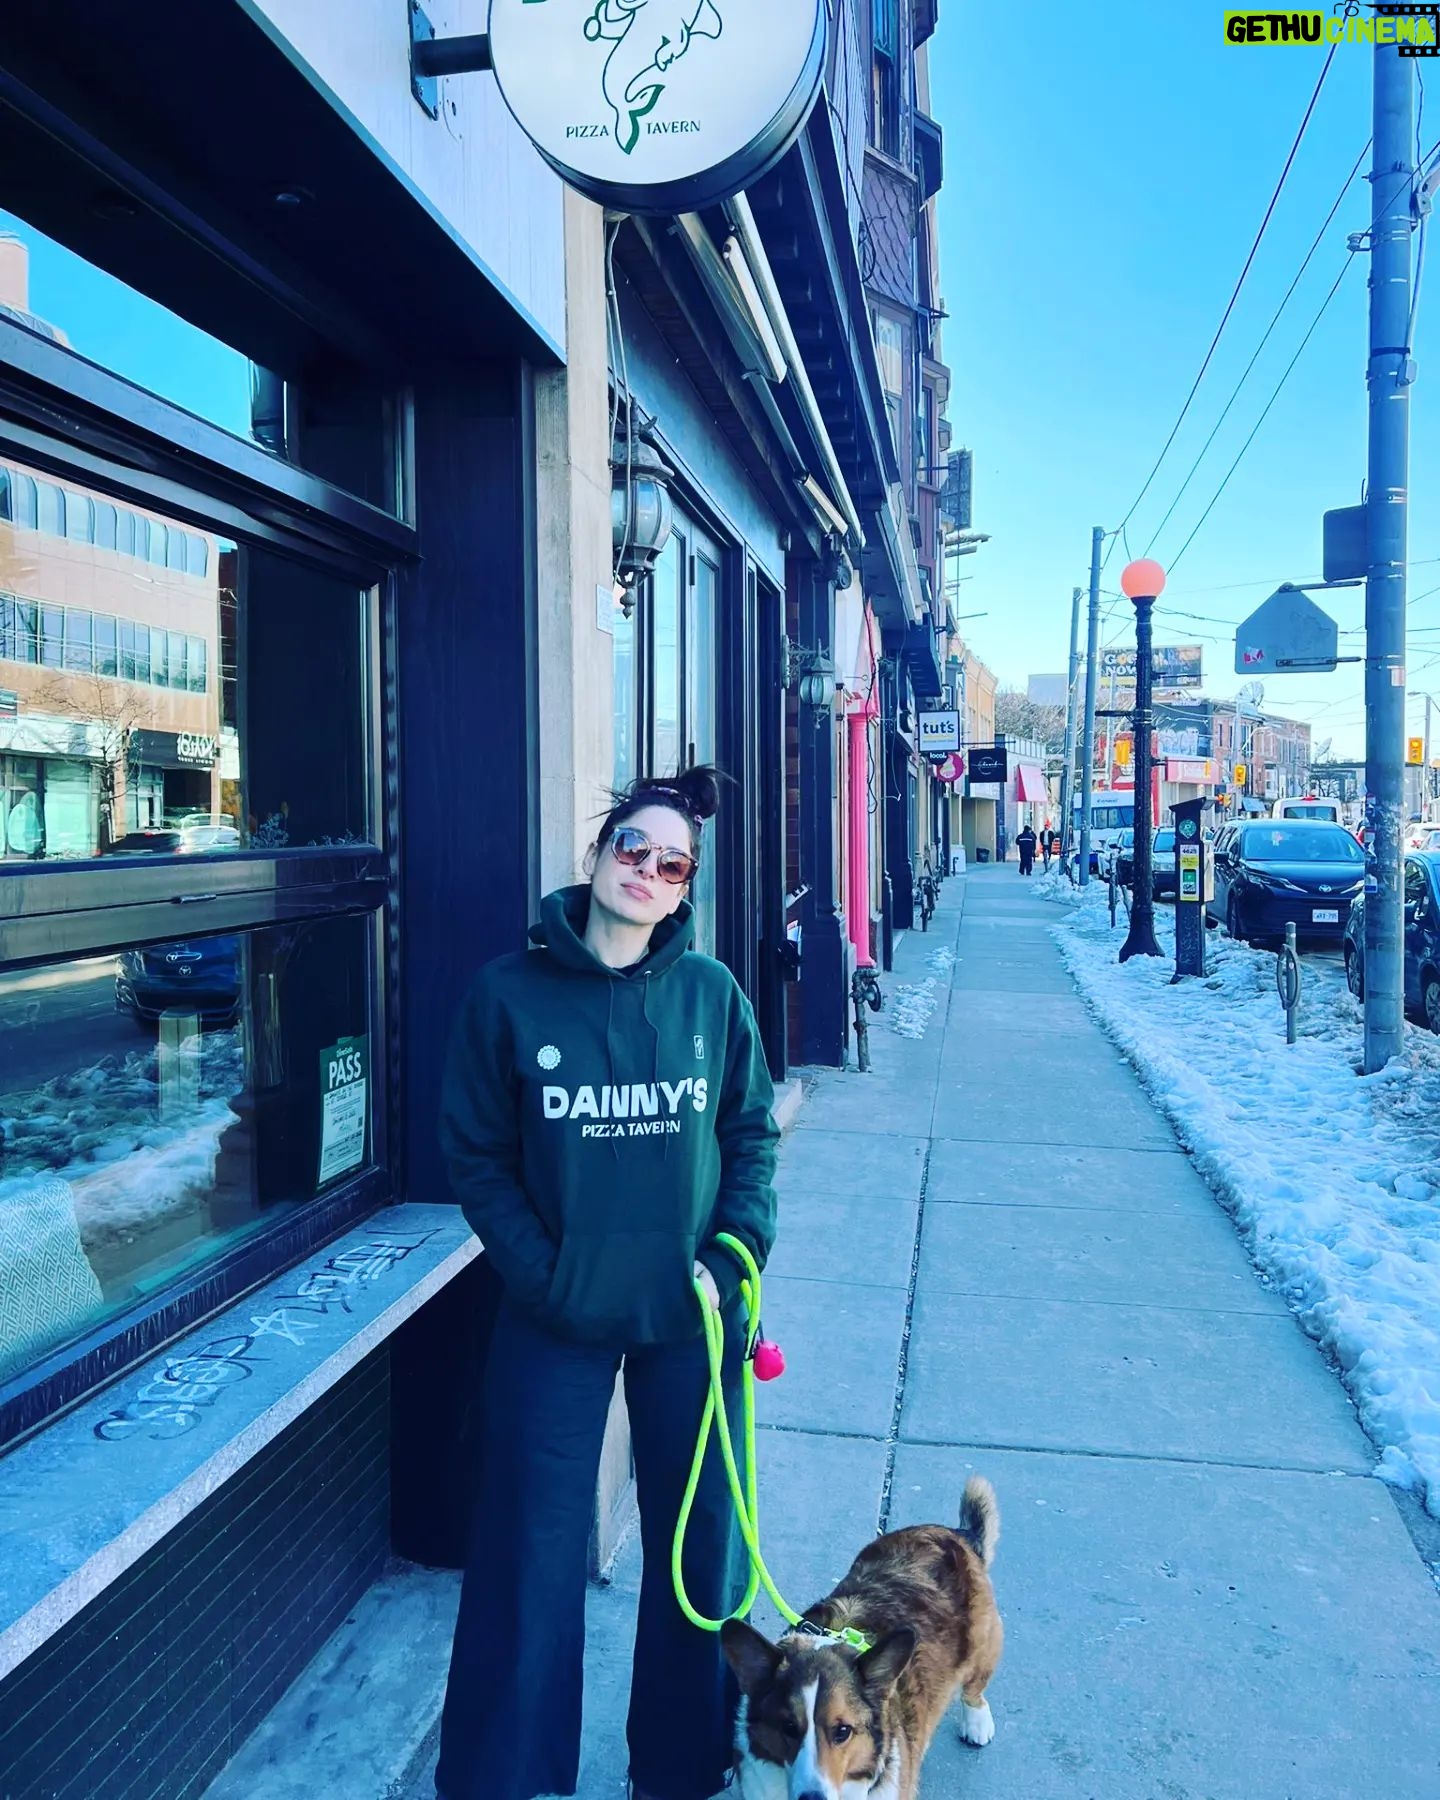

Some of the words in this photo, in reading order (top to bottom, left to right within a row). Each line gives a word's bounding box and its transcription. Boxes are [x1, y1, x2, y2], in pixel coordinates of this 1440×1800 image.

[566, 125, 610, 138] PIZZA
[646, 120, 701, 134] TAVERN
[923, 720, 955, 734] tut's
[329, 1051, 361, 1089] PASS
[542, 1077, 708, 1119] DANNY'S
[582, 1123, 625, 1138] PIZZA
[627, 1120, 681, 1136] TAVERN
